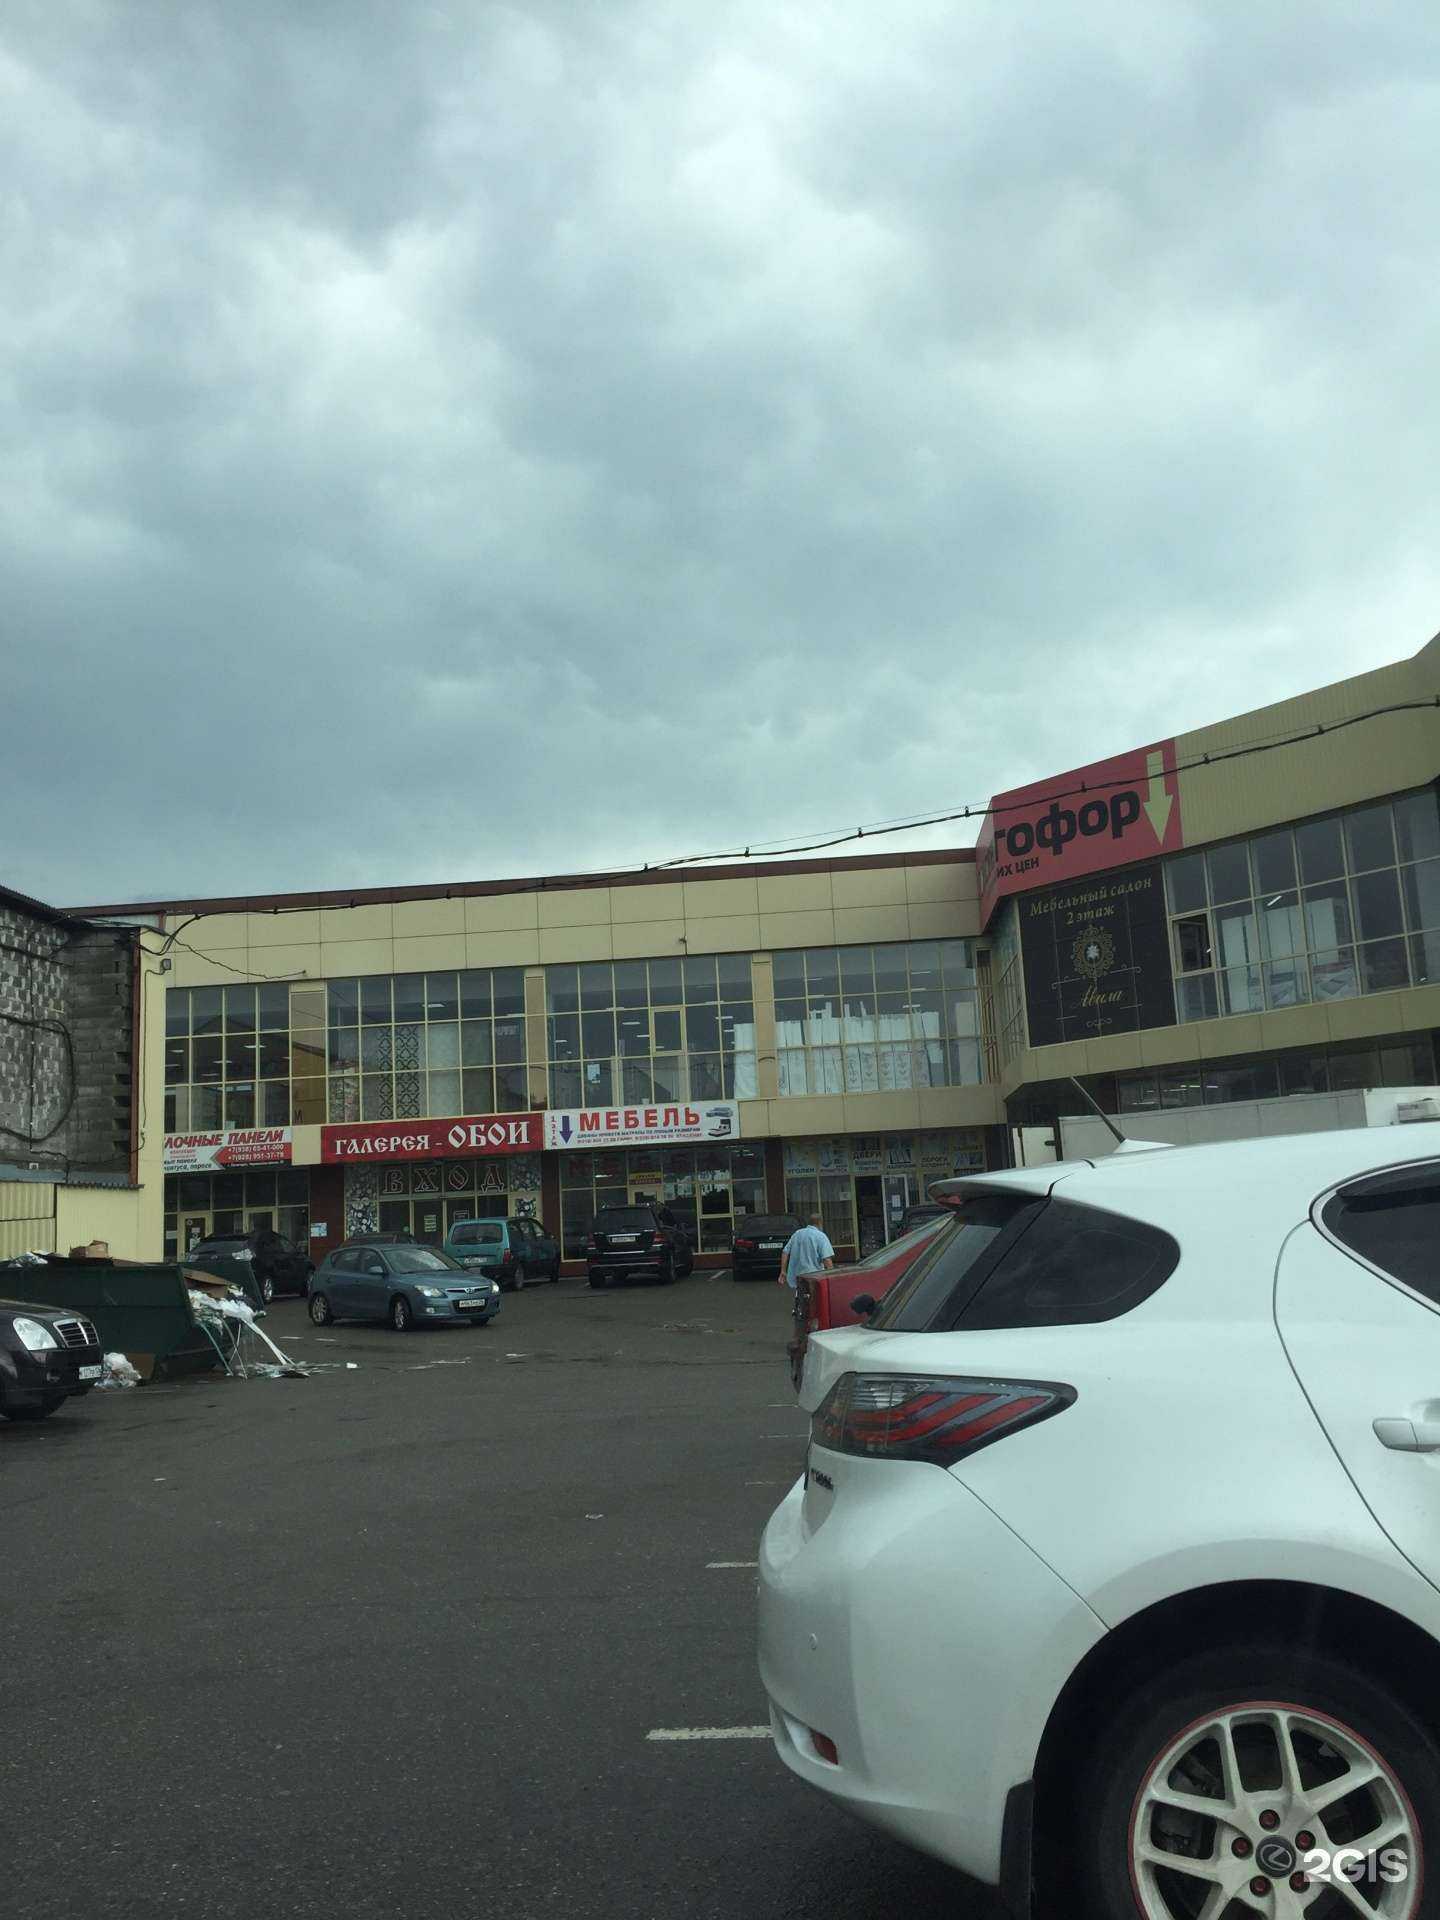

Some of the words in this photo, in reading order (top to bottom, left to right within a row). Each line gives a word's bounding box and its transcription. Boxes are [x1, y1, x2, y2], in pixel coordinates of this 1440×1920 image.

[1016, 857, 1040, 874] ЦЕН
[1030, 886, 1107, 917] Мебельный
[1110, 877, 1153, 895] салон
[1066, 911, 1074, 925] 2
[1076, 904, 1115, 921] этаж
[579, 1107, 701, 1131] МЕБЕЛЬ
[164, 1134, 224, 1149] ЛОЧНЫЕ
[228, 1130, 284, 1145] ПАНЕЛИ
[335, 1134, 431, 1155] ГАЛЕРЕЯ
[447, 1121, 531, 1149] ОБОИ
[383, 1164, 505, 1194] ВХОД
